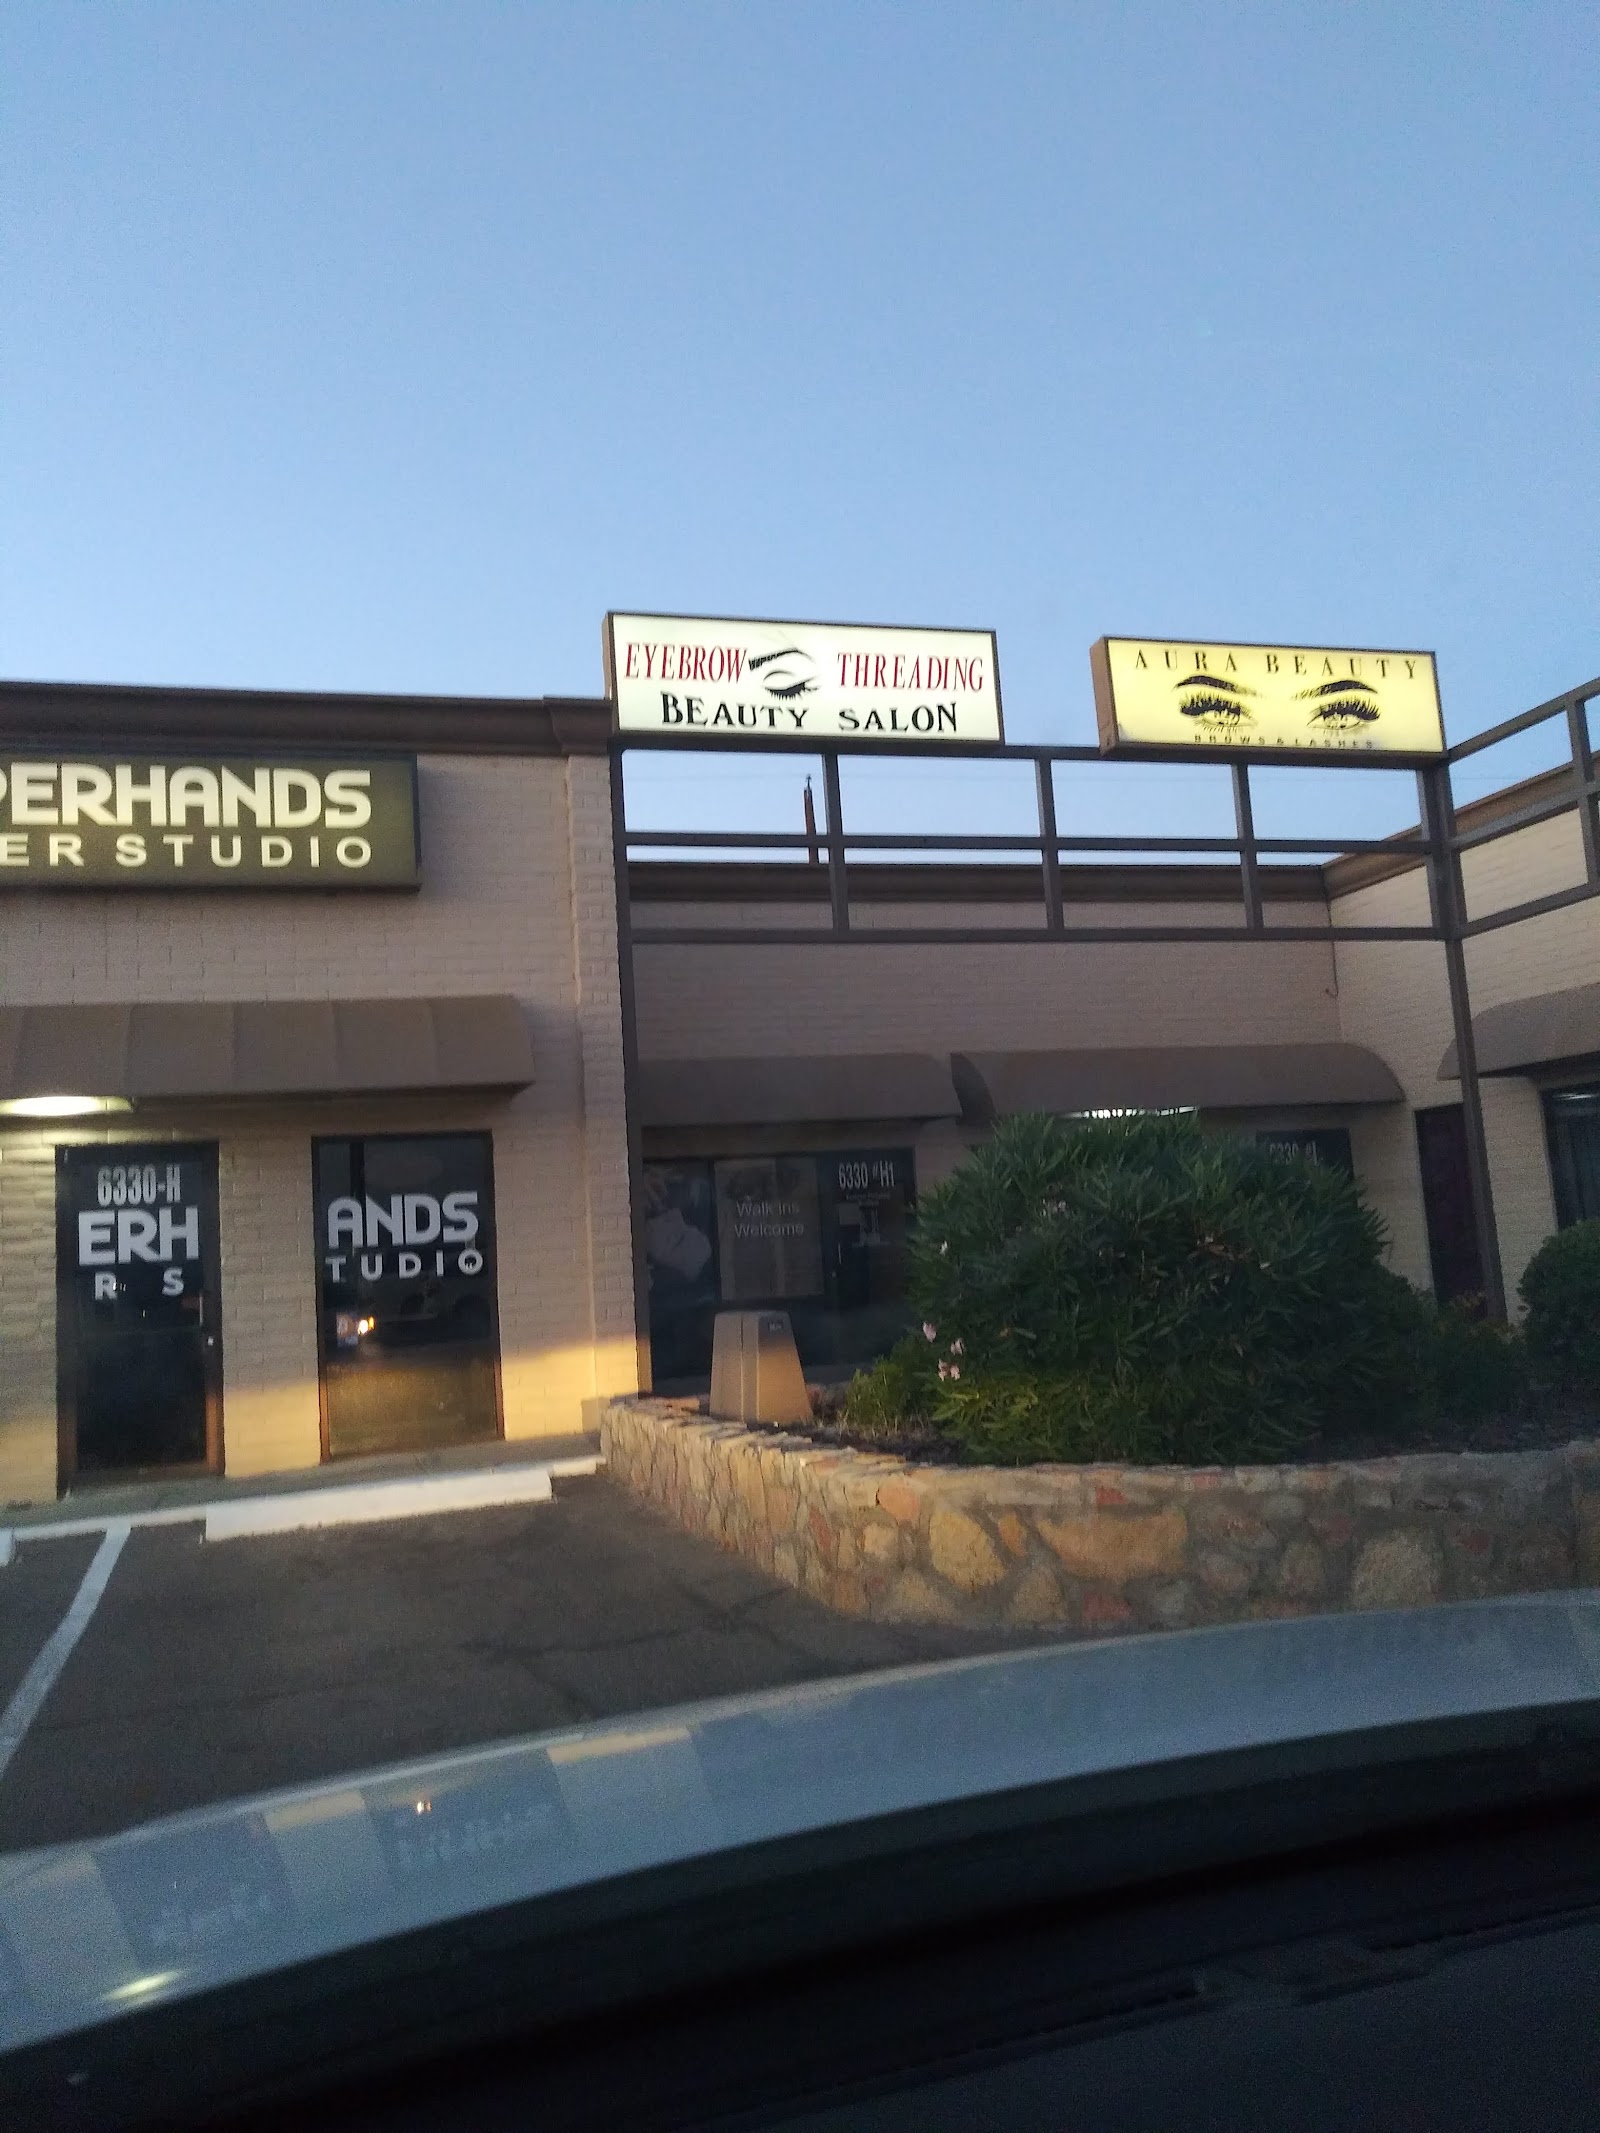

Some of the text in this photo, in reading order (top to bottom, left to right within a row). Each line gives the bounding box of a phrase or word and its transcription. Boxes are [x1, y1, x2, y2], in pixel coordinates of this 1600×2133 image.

[625, 642, 984, 692] EYEBROW THREADING
[1135, 648, 1418, 680] AURA BEAUTY
[660, 691, 958, 733] BEAUTY SALON
[1294, 738, 1373, 749] LASHES
[0, 761, 372, 829] ERHANDS
[115, 833, 373, 868] STUDIO
[96, 1164, 182, 1206] 6330-H
[838, 1160, 869, 1191] 6330
[77, 1205, 200, 1266] ERH
[327, 1190, 479, 1250] ANDS
[734, 1223, 804, 1239] Welcome
[324, 1250, 485, 1283] TUDIO
